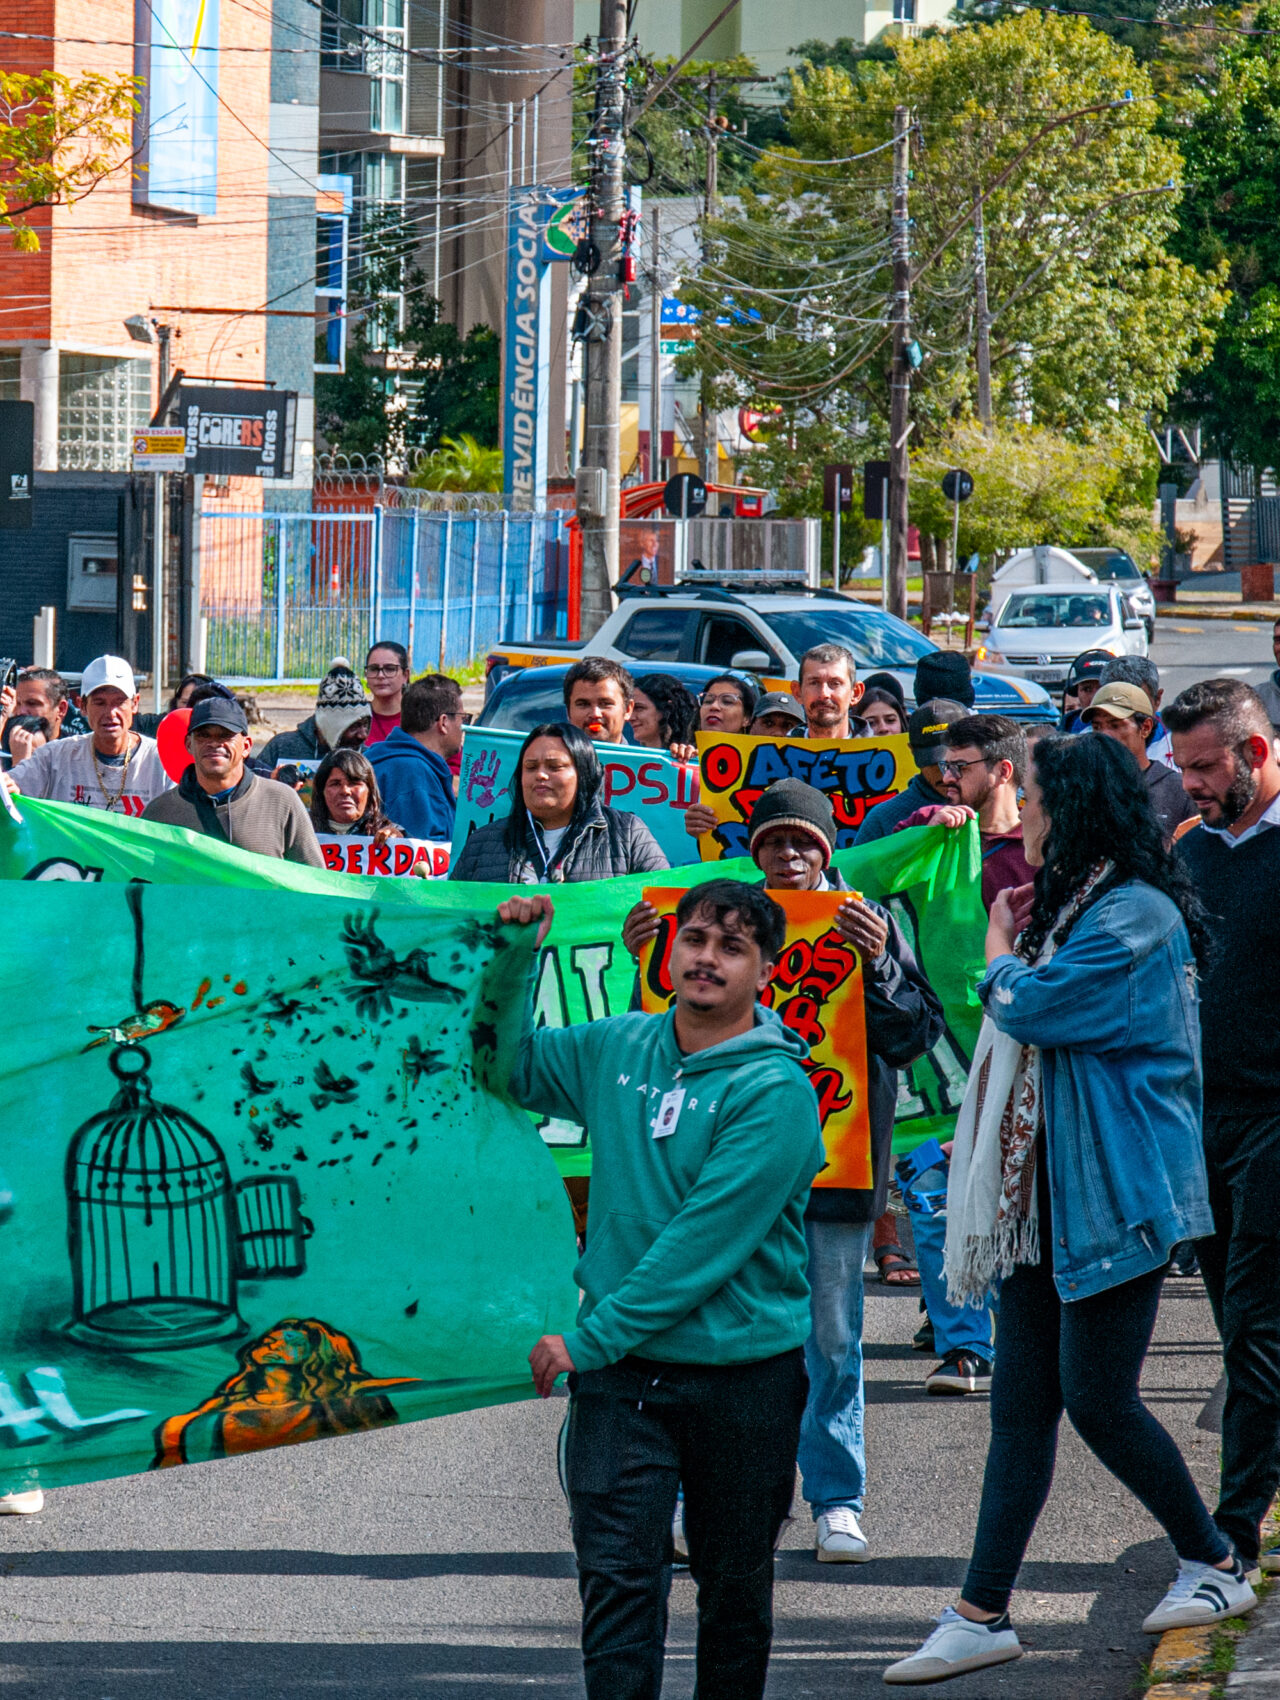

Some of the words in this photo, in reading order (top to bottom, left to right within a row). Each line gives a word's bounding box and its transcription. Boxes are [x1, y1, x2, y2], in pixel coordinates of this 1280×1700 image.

[702, 743, 742, 793] O
[744, 743, 896, 795] AFETO
[320, 843, 451, 877] BERDAD
[617, 1073, 717, 1113] NATRE
